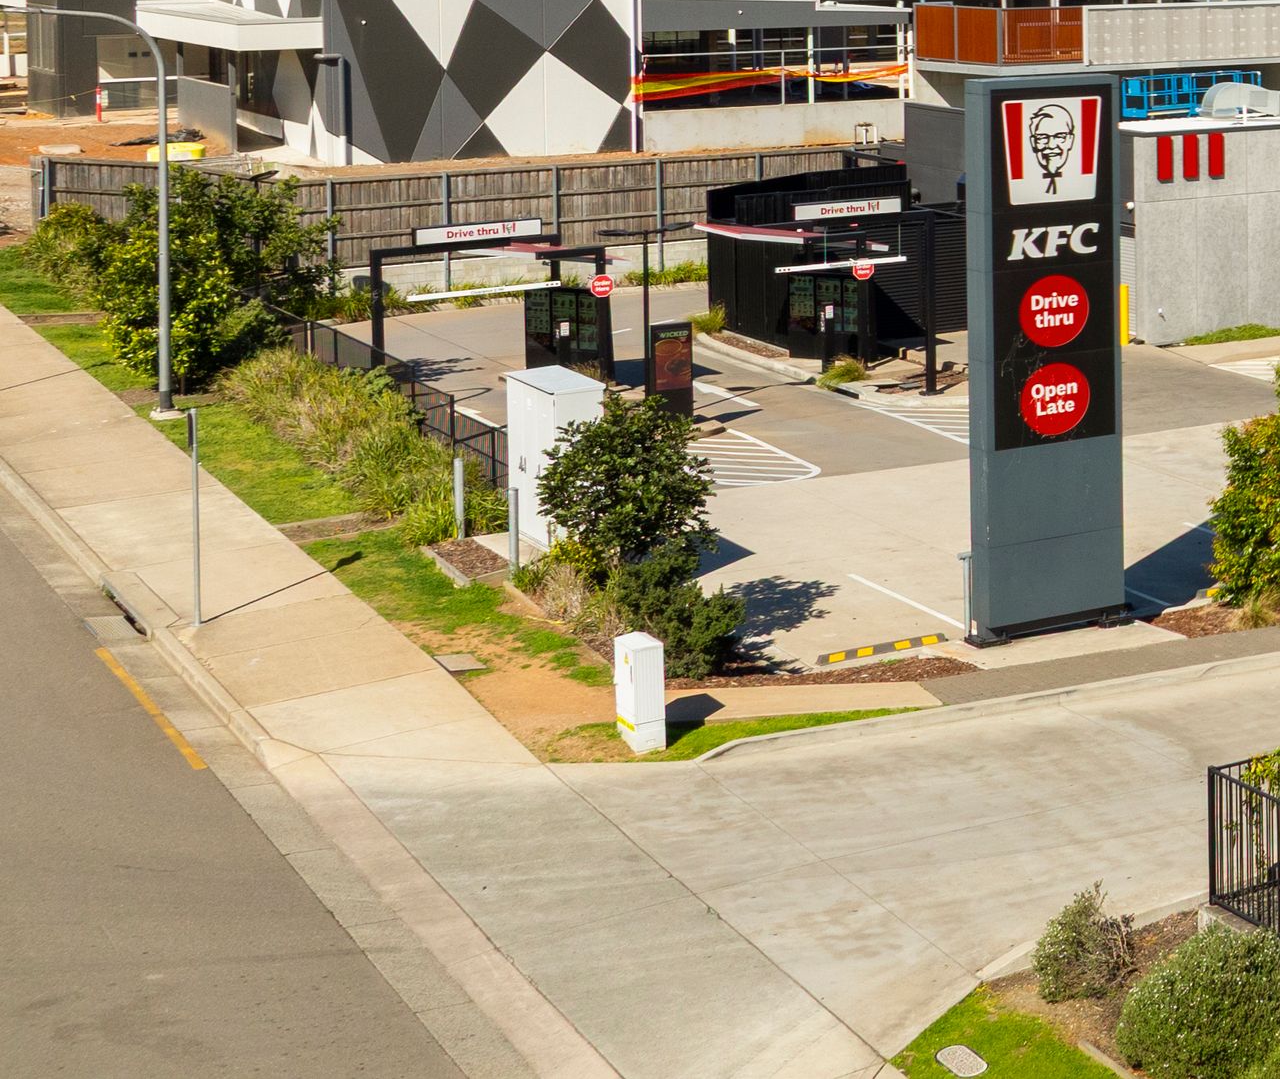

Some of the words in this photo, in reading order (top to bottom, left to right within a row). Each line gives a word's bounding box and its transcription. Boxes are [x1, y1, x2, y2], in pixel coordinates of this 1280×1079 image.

[820, 206, 844, 215] Drive
[447, 230, 474, 239] Drive
[477, 227, 499, 236] thru
[1007, 223, 1099, 261] KFC
[1031, 292, 1079, 311] Drive
[1035, 311, 1074, 328] thru
[1031, 382, 1078, 401] Open
[1036, 399, 1075, 417] Late
